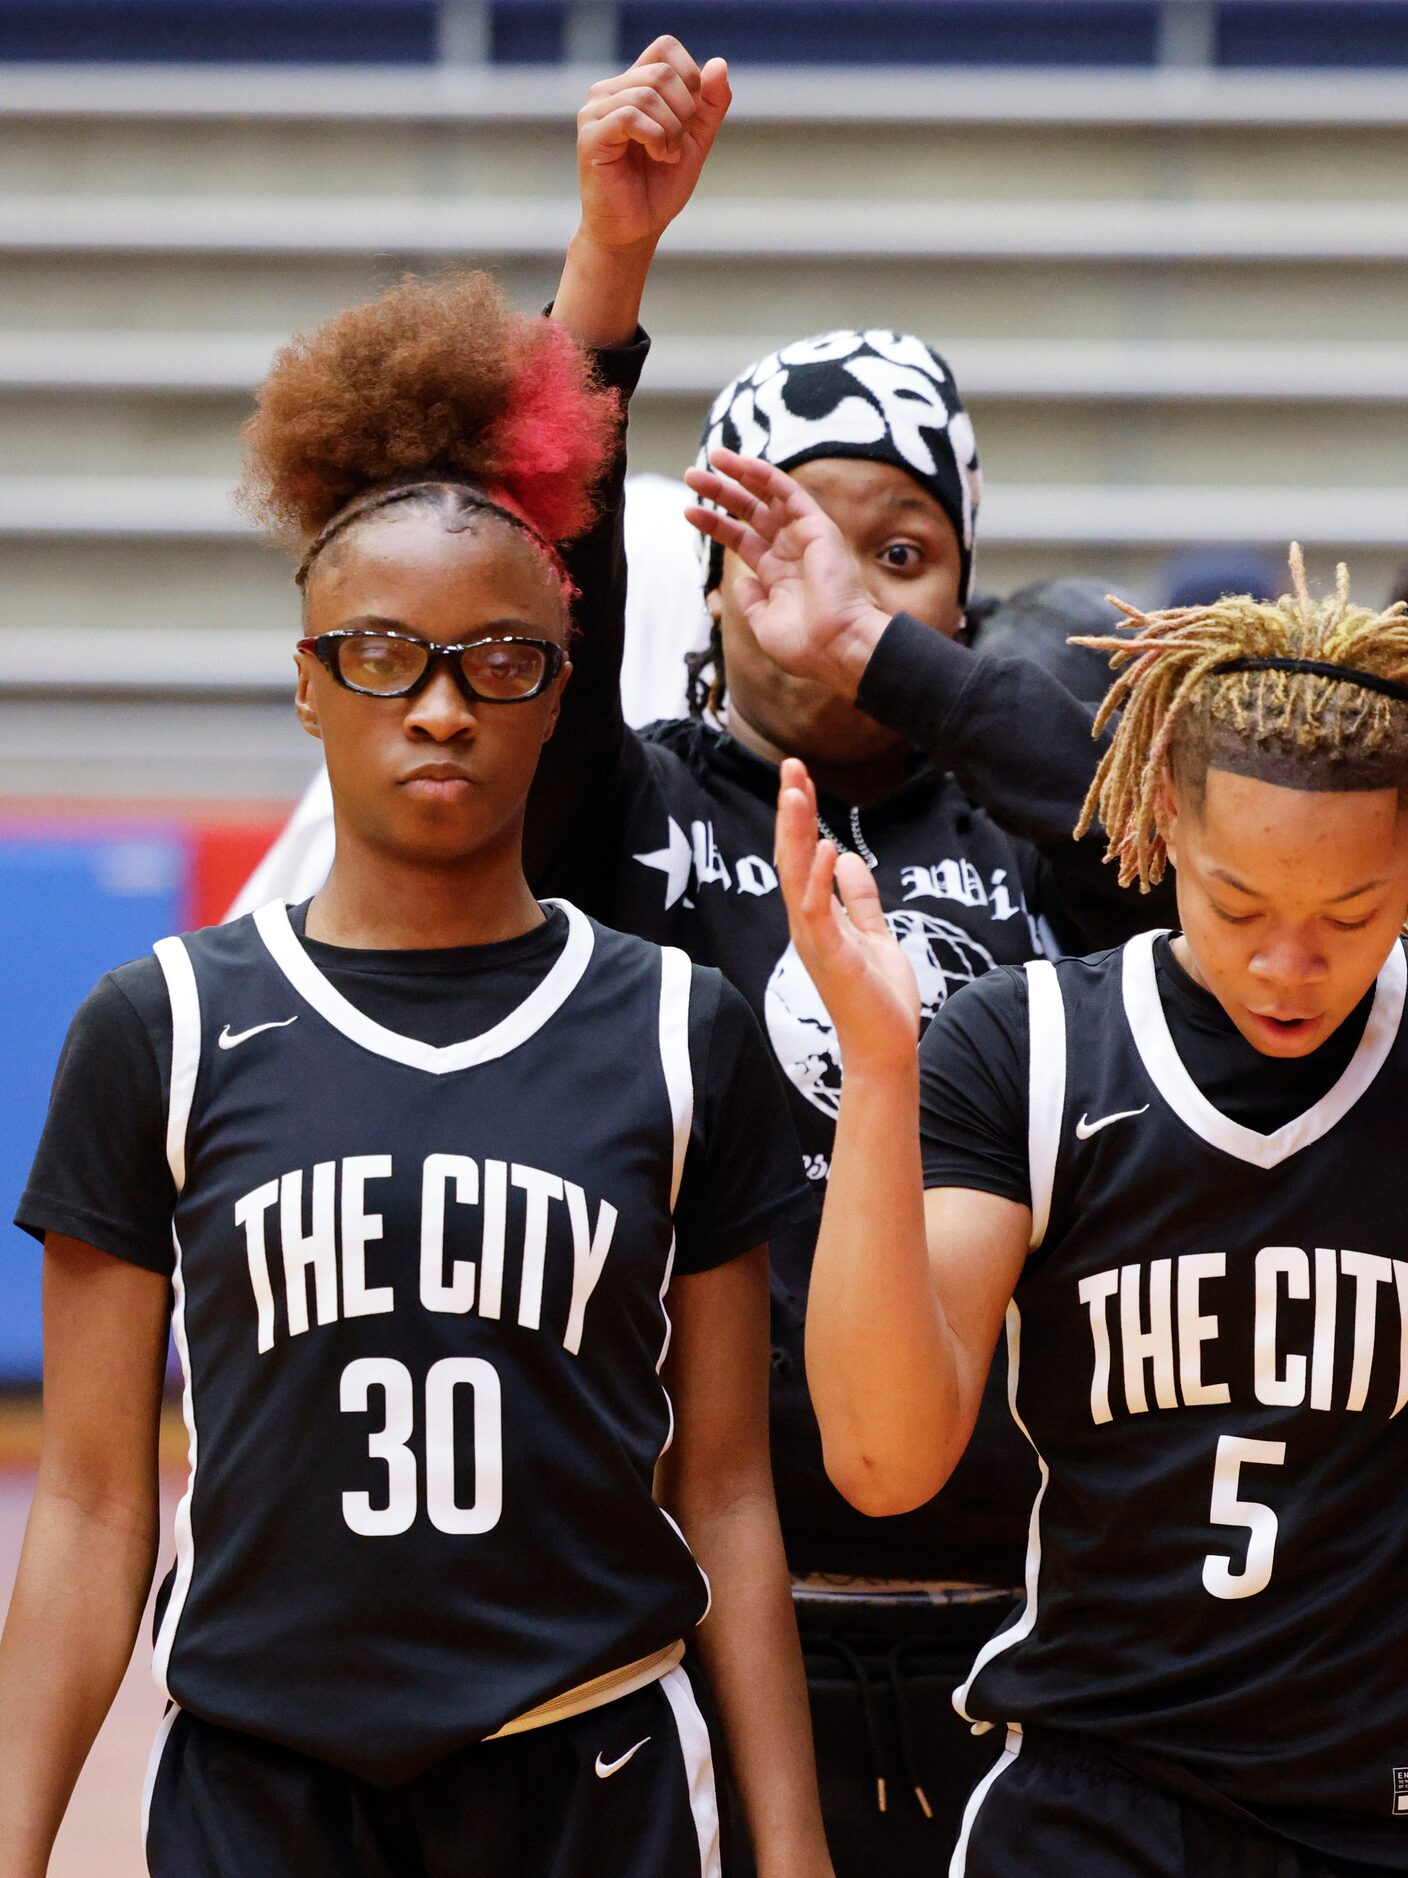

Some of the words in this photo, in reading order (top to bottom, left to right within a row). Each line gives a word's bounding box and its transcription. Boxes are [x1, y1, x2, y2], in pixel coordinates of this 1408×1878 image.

[234, 1154, 395, 1355] THE
[419, 1152, 619, 1356] CITY
[1078, 1252, 1231, 1425] THE
[339, 1356, 503, 1537] 30
[1201, 1434, 1287, 1600] 5
